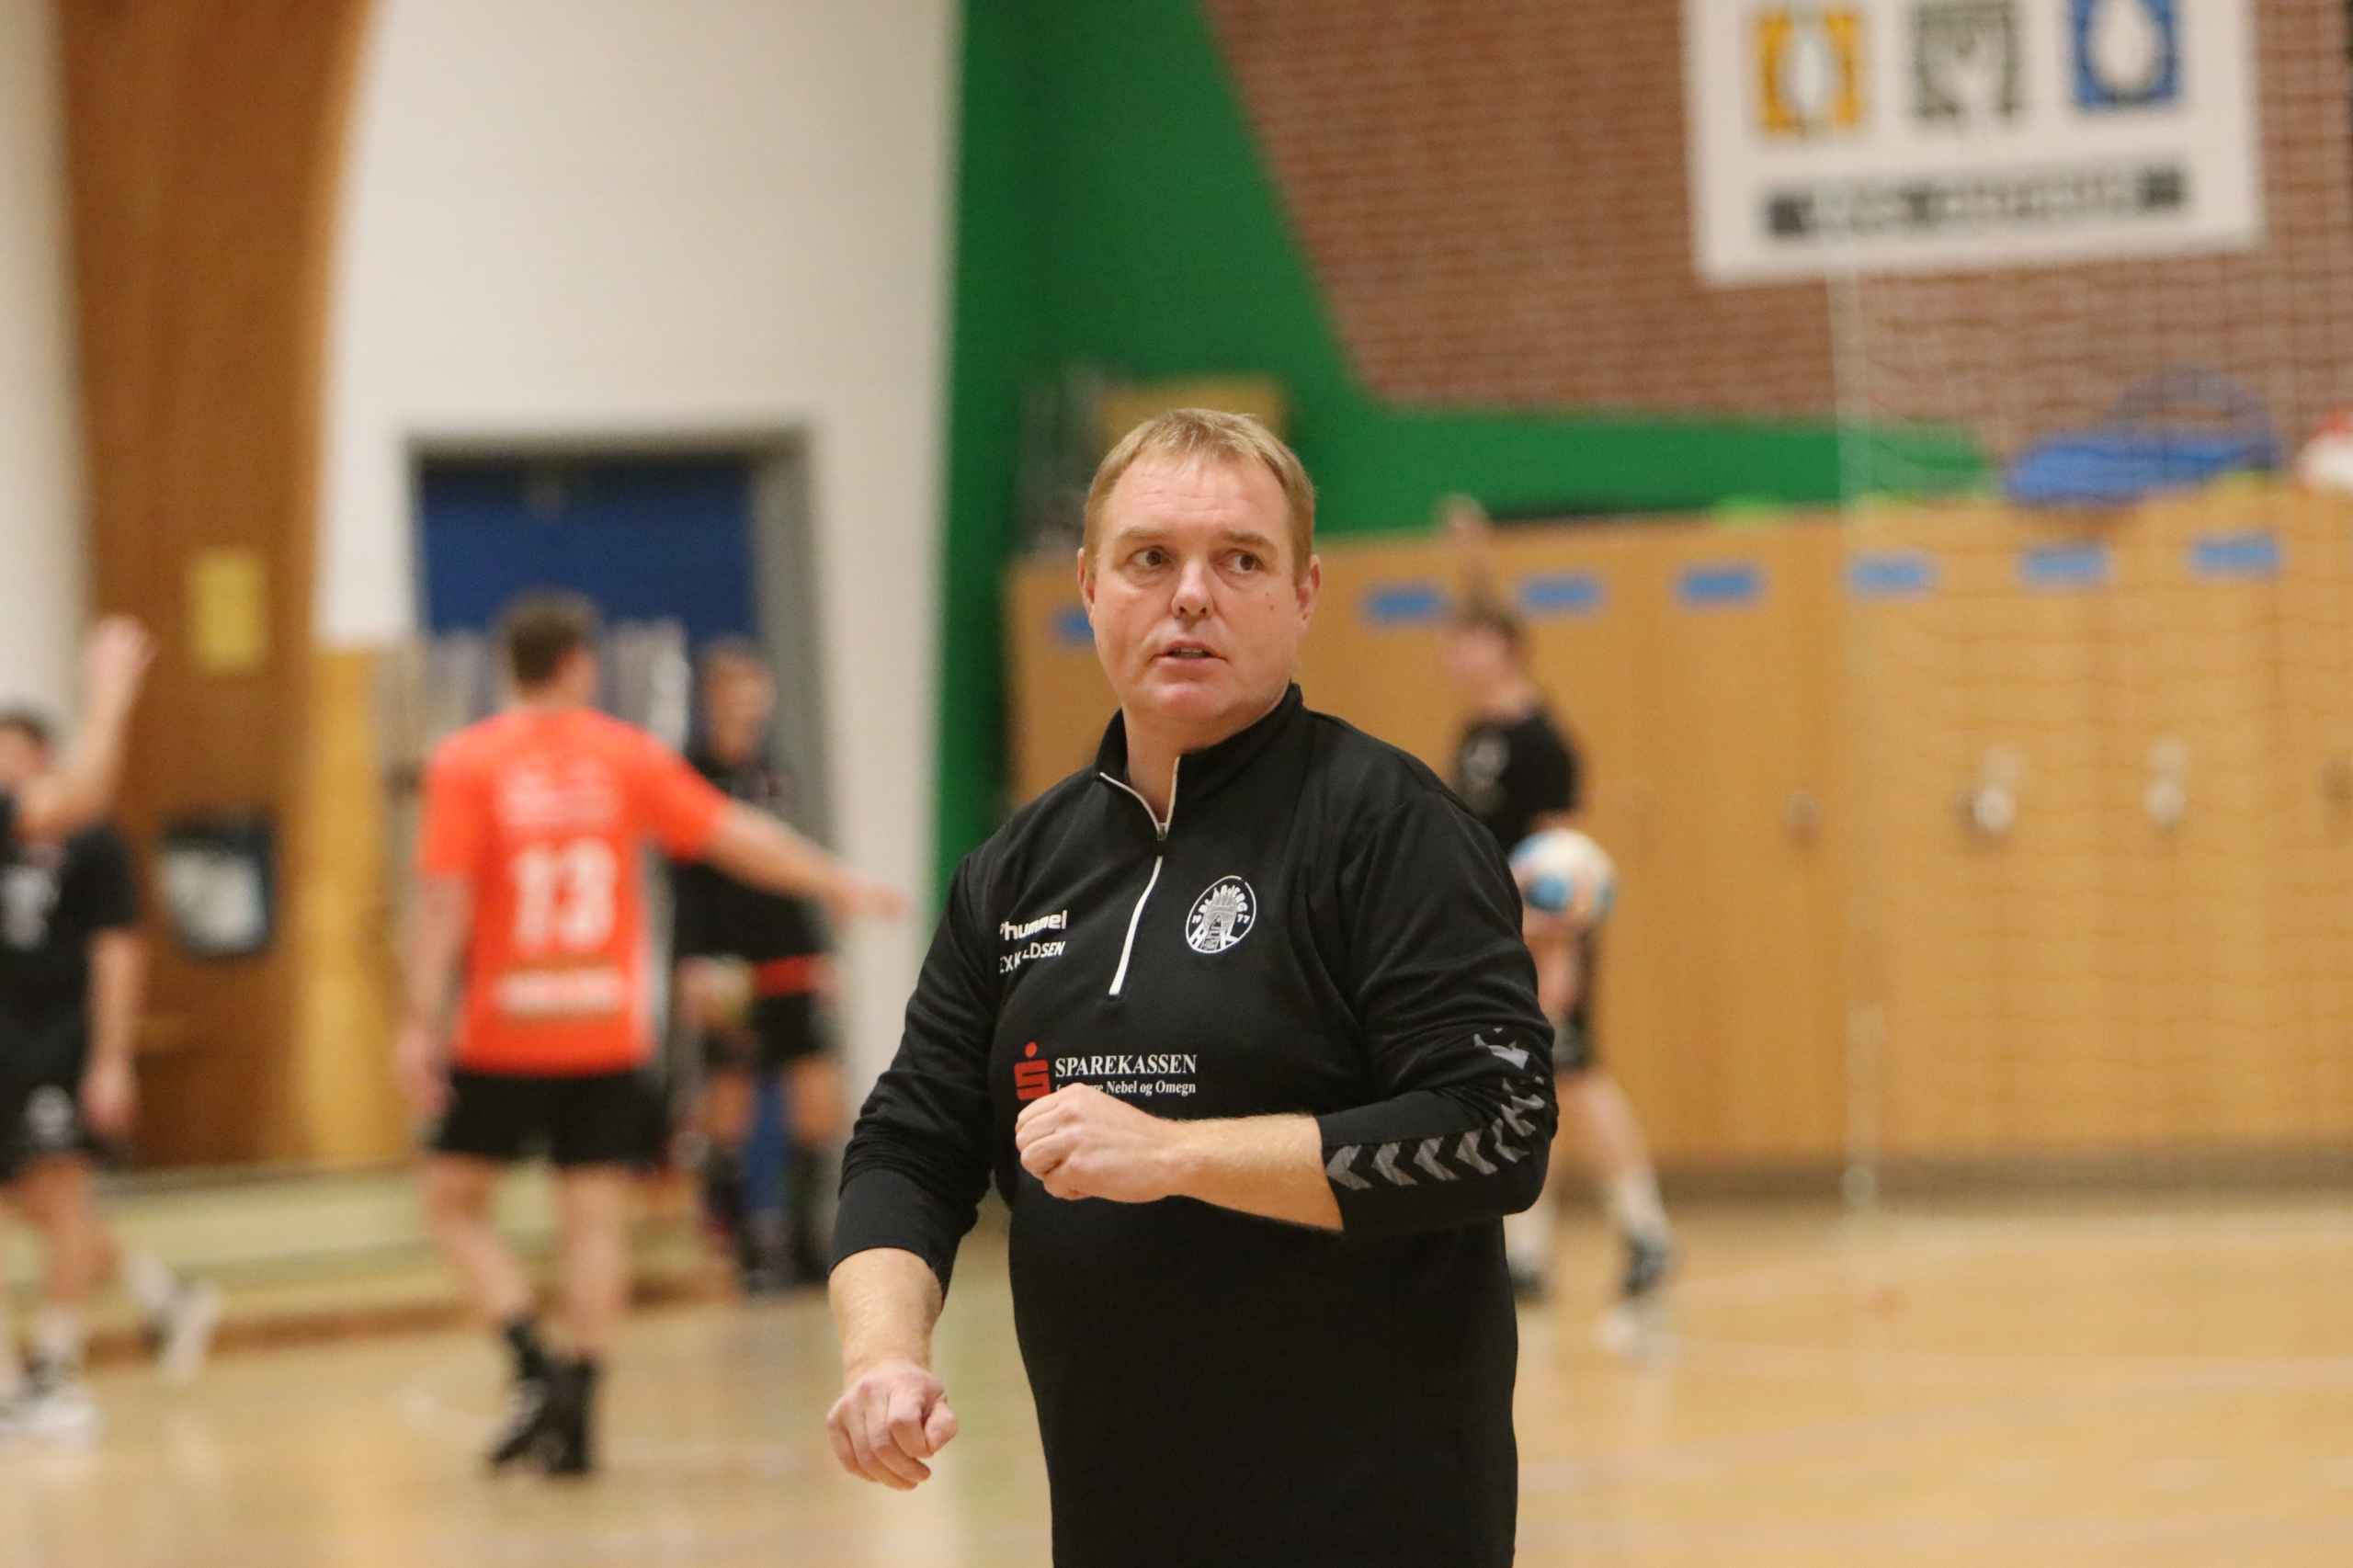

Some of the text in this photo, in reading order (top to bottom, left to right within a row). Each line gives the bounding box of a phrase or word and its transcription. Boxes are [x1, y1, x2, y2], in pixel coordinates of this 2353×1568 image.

[508, 838, 619, 950] 13
[1055, 1054, 1197, 1077] SPAREKASSEN
[1107, 1080, 1137, 1094] Nebel
[1140, 1083, 1153, 1096] og
[1155, 1080, 1197, 1096] Omegn
